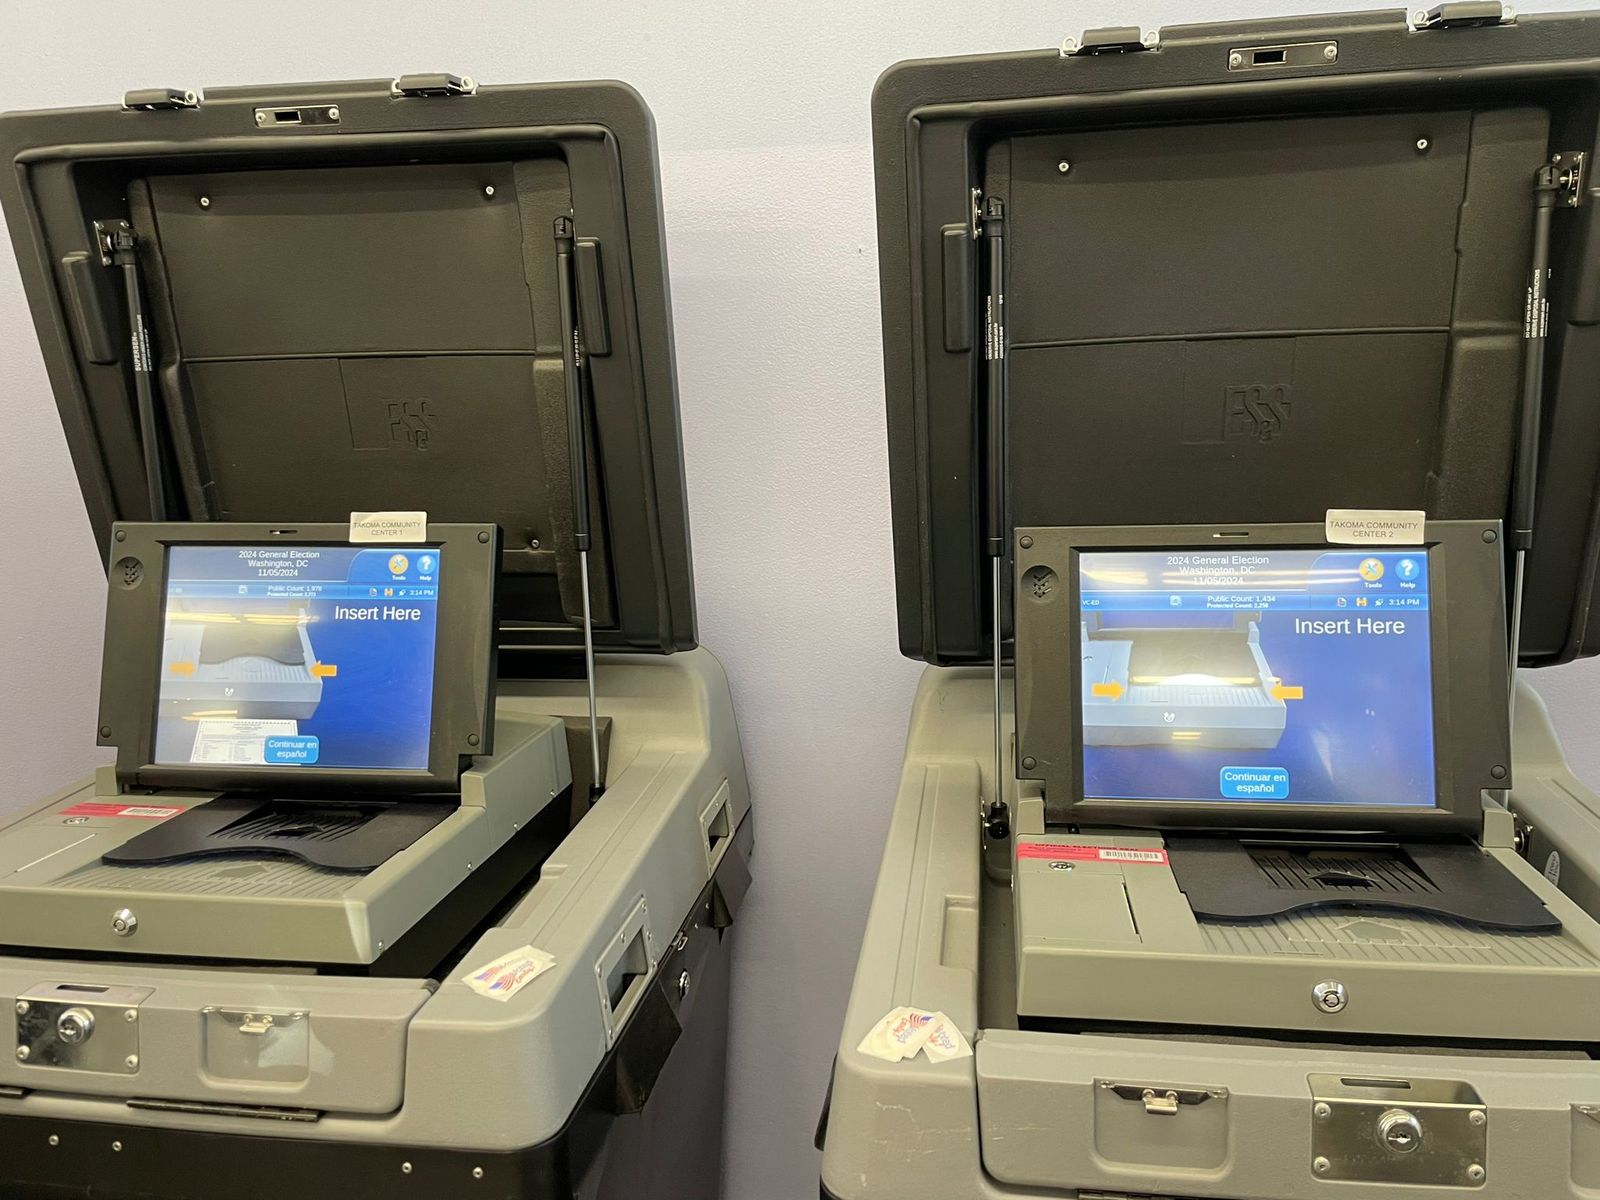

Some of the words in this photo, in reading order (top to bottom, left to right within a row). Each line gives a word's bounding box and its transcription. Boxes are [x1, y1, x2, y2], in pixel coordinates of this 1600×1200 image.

[1330, 520, 1364, 528] TAKOMA
[1366, 521, 1418, 529] COMMUNITY
[1352, 530, 1387, 538] CENTER
[1388, 530, 1394, 538] 2
[238, 550, 257, 558] 2024
[258, 550, 288, 558] General
[290, 550, 320, 558] Election
[248, 560, 294, 568] Washington,
[1167, 556, 1190, 565] 2024
[1192, 556, 1229, 565] General
[1232, 556, 1270, 565] Election
[1179, 566, 1238, 576] Washington,
[1240, 566, 1256, 574] DC
[334, 606, 379, 620] Insert
[382, 606, 421, 620] Here
[1295, 618, 1351, 634] Insert
[1356, 618, 1405, 634] Here
[268, 740, 305, 748] Continuar
[276, 750, 307, 759] español
[1224, 772, 1271, 782] Continuar
[1273, 774, 1286, 782] en
[1236, 784, 1275, 794] español
